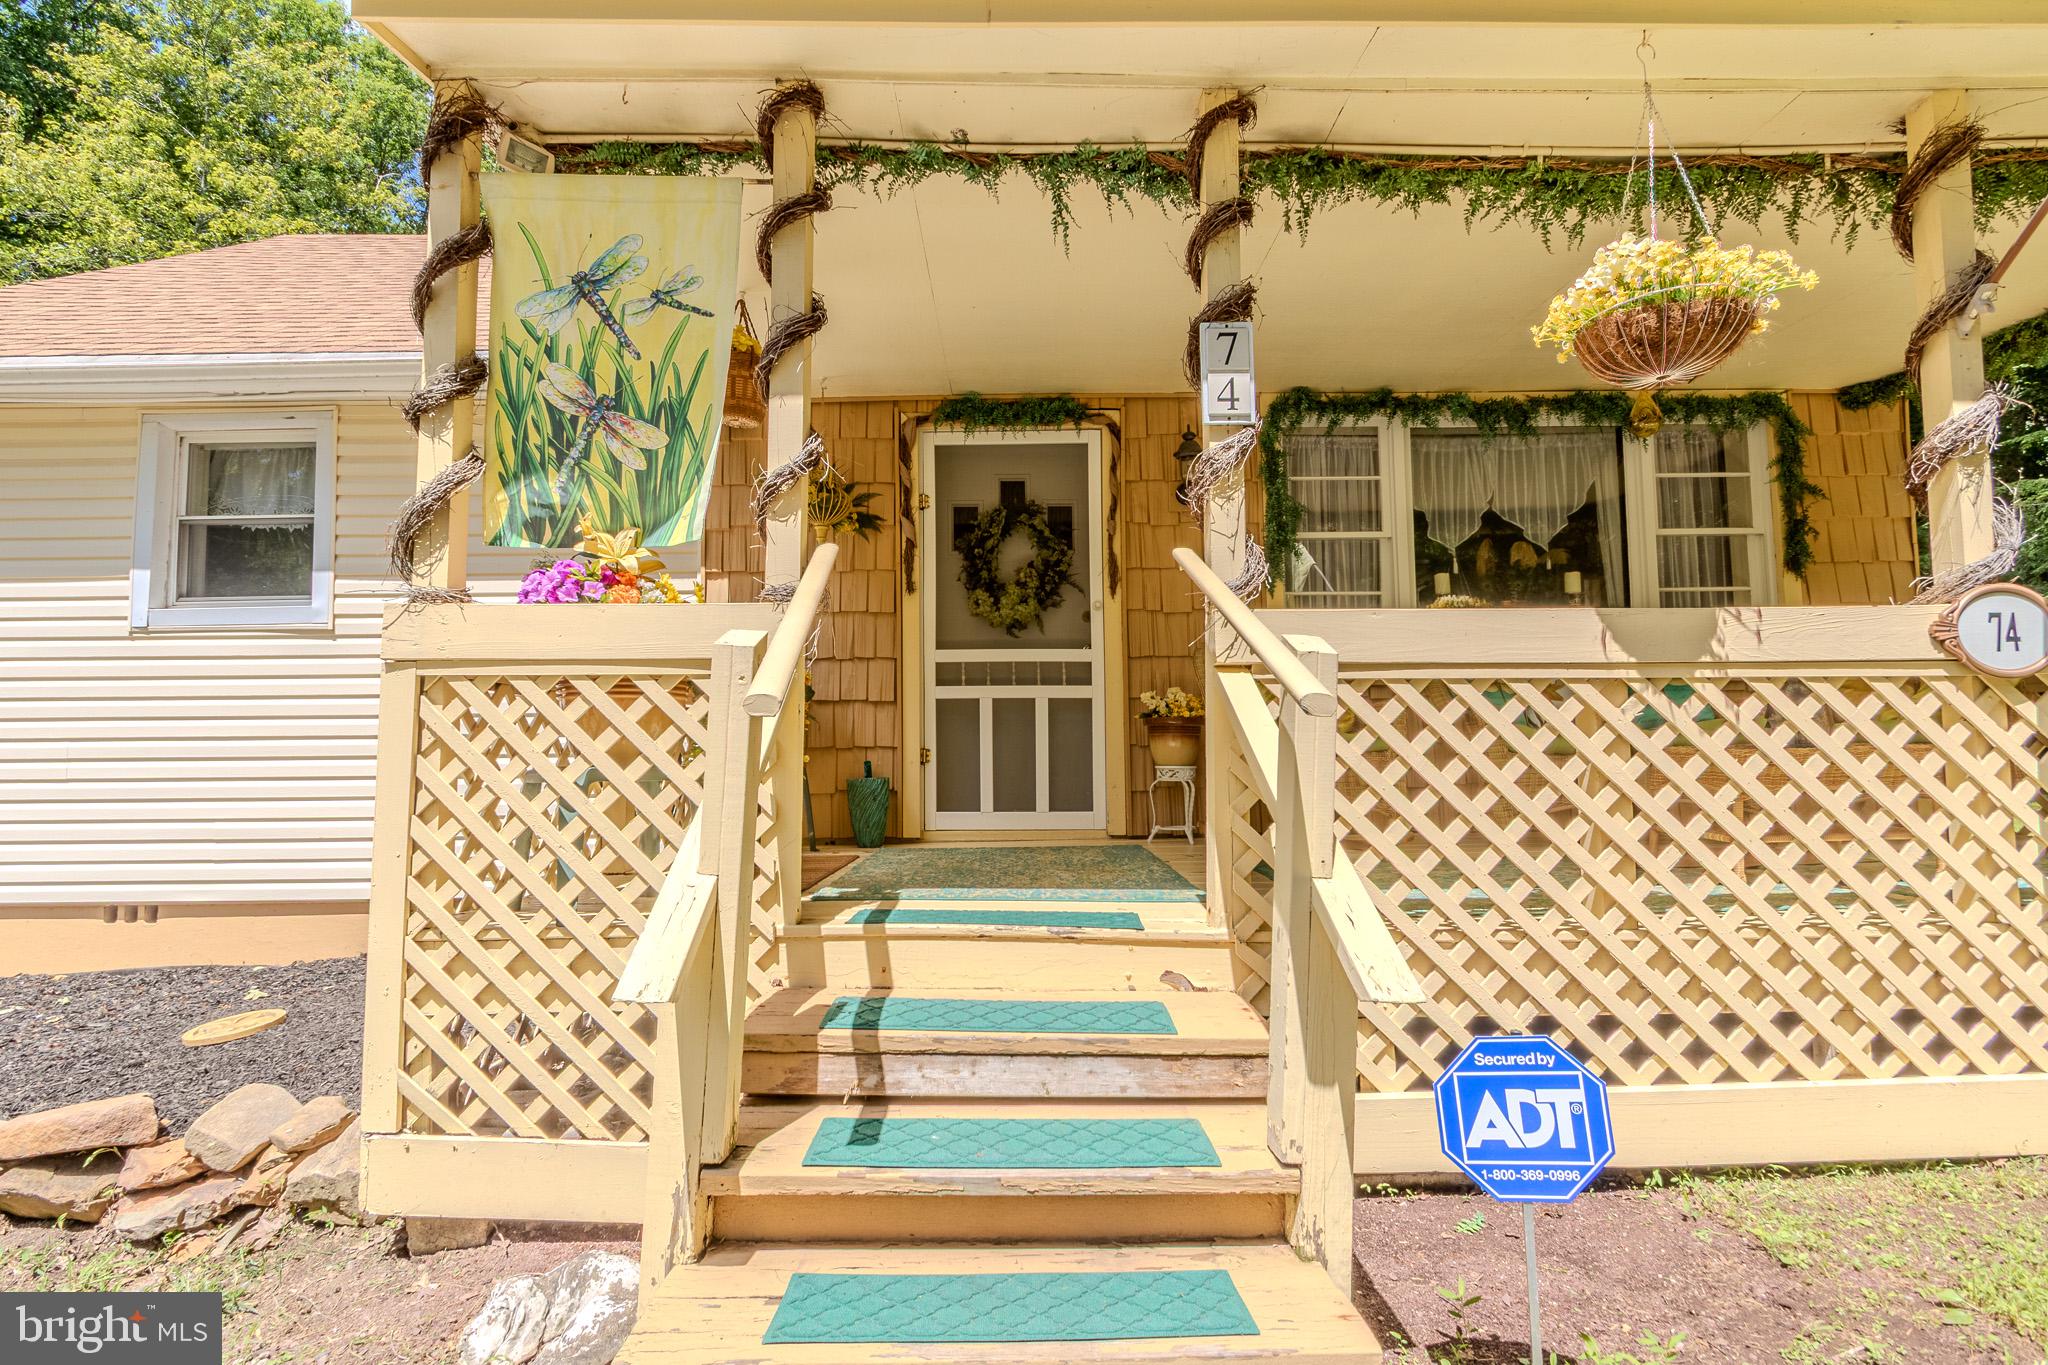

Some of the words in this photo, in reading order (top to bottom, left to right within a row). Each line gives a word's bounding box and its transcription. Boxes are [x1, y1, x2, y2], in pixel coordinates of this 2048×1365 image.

[1988, 612, 2021, 652] 74
[1474, 1052, 1535, 1065] Secured
[1537, 1052, 1555, 1067] by
[1481, 1169, 1581, 1181] 1-800-369-0996
